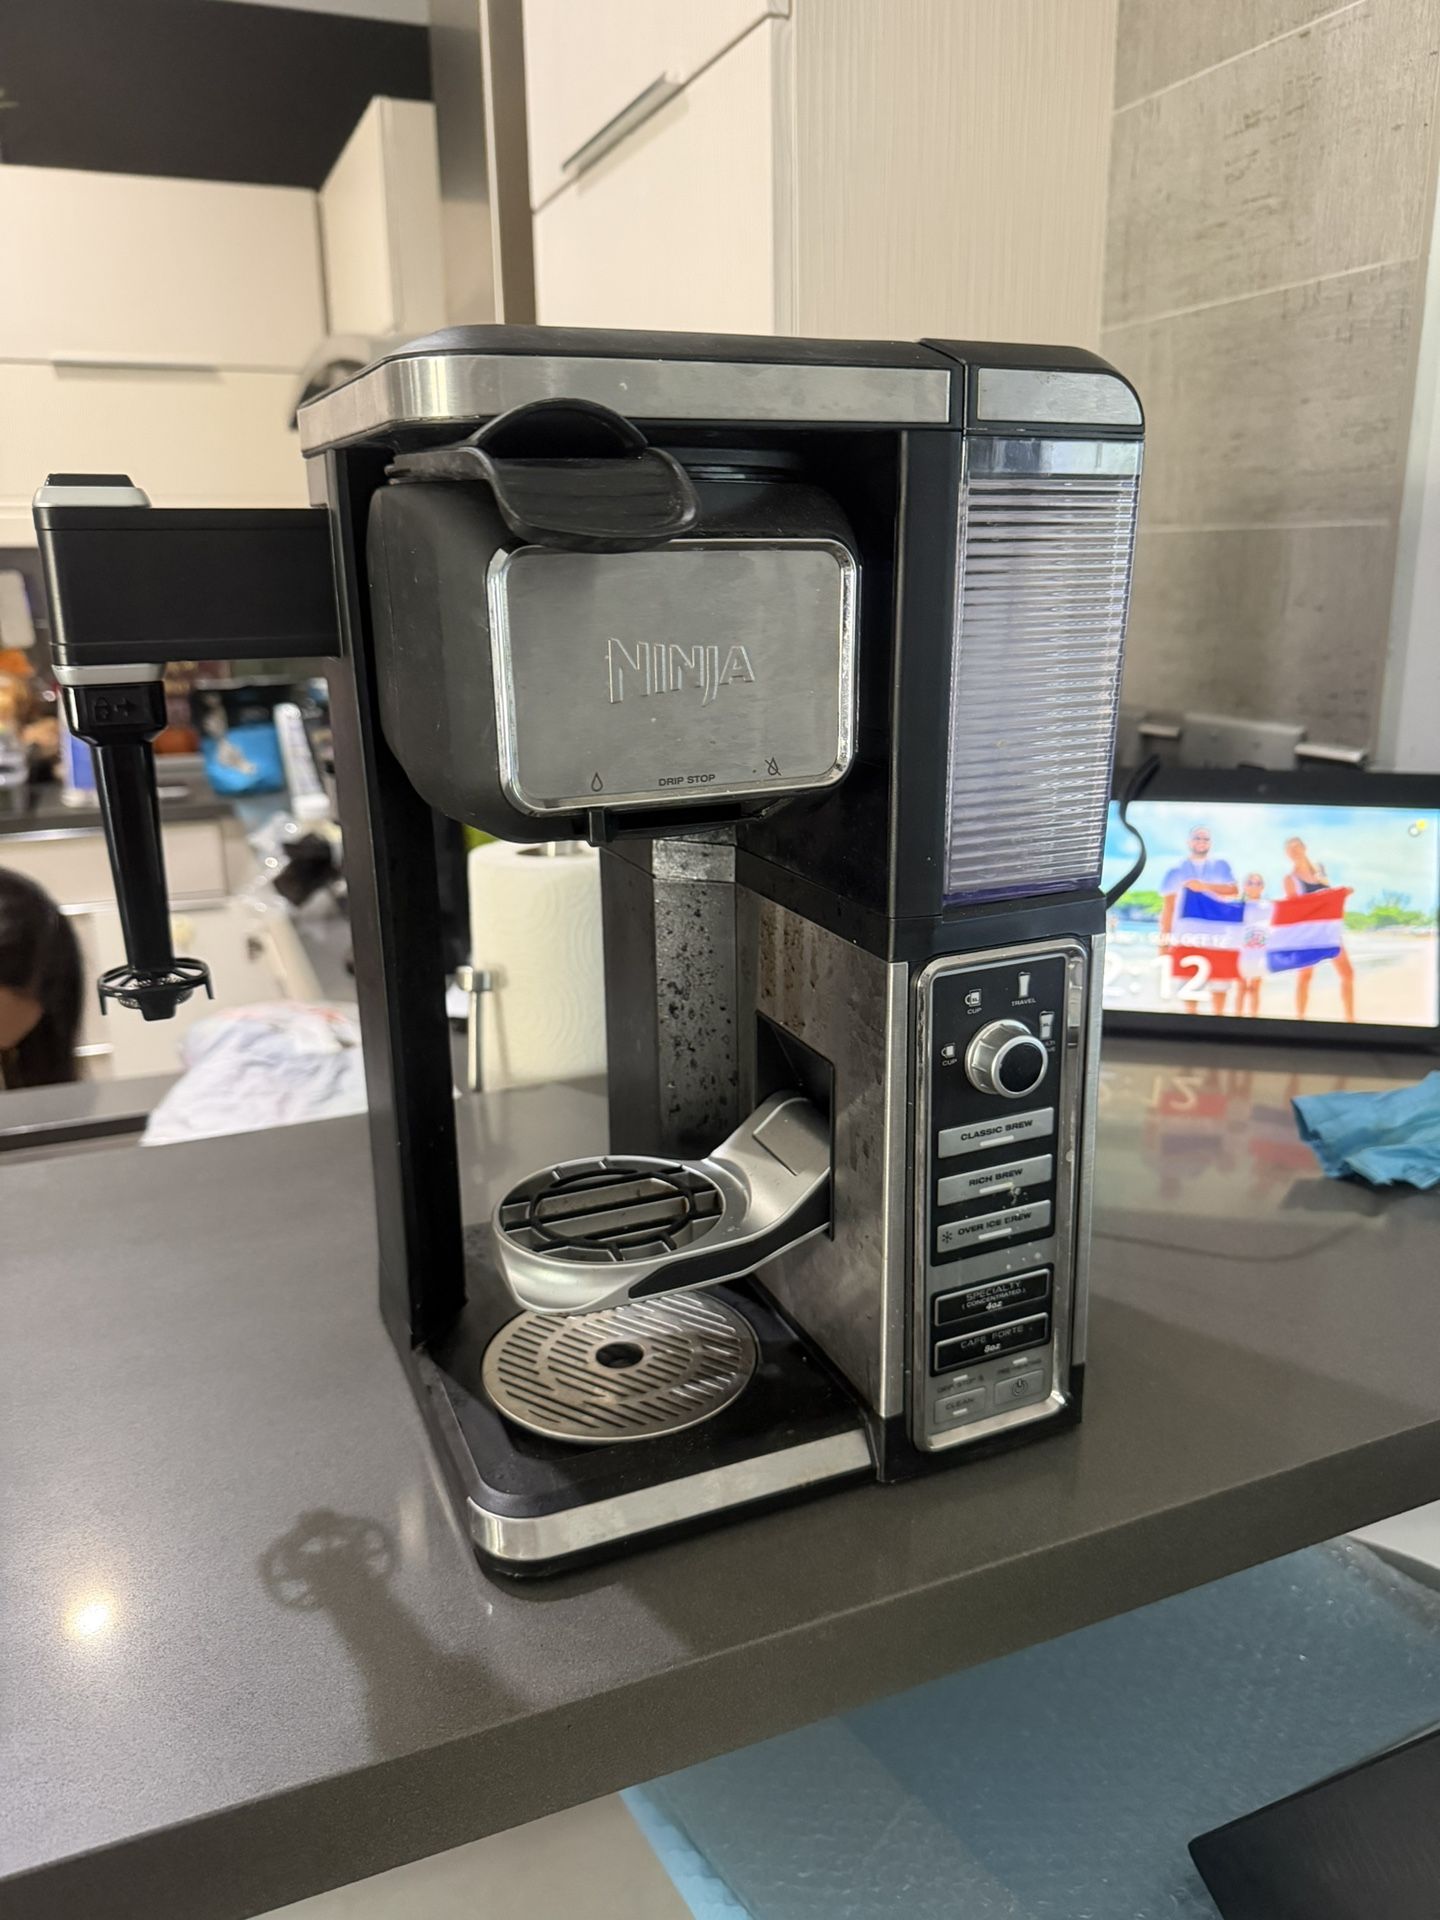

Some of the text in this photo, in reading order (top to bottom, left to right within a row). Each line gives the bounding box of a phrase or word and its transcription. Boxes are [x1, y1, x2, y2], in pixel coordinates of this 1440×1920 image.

[608, 637, 756, 708] NINJA
[658, 773, 716, 787] DRIP STOP
[1010, 998, 1037, 1007] TRAVEL
[966, 1006, 982, 1015] CUP
[941, 1058, 958, 1067] CUP
[960, 1119, 1034, 1141] CLASSIC BREW
[968, 1168, 1023, 1187] RICH BREW
[957, 1223, 984, 1236] OVER
[986, 1217, 1002, 1229] ICE
[966, 1280, 1022, 1302] SPECIALTY
[991, 1325, 1024, 1340] FORTE
[945, 1398, 975, 1410] CLEAN
